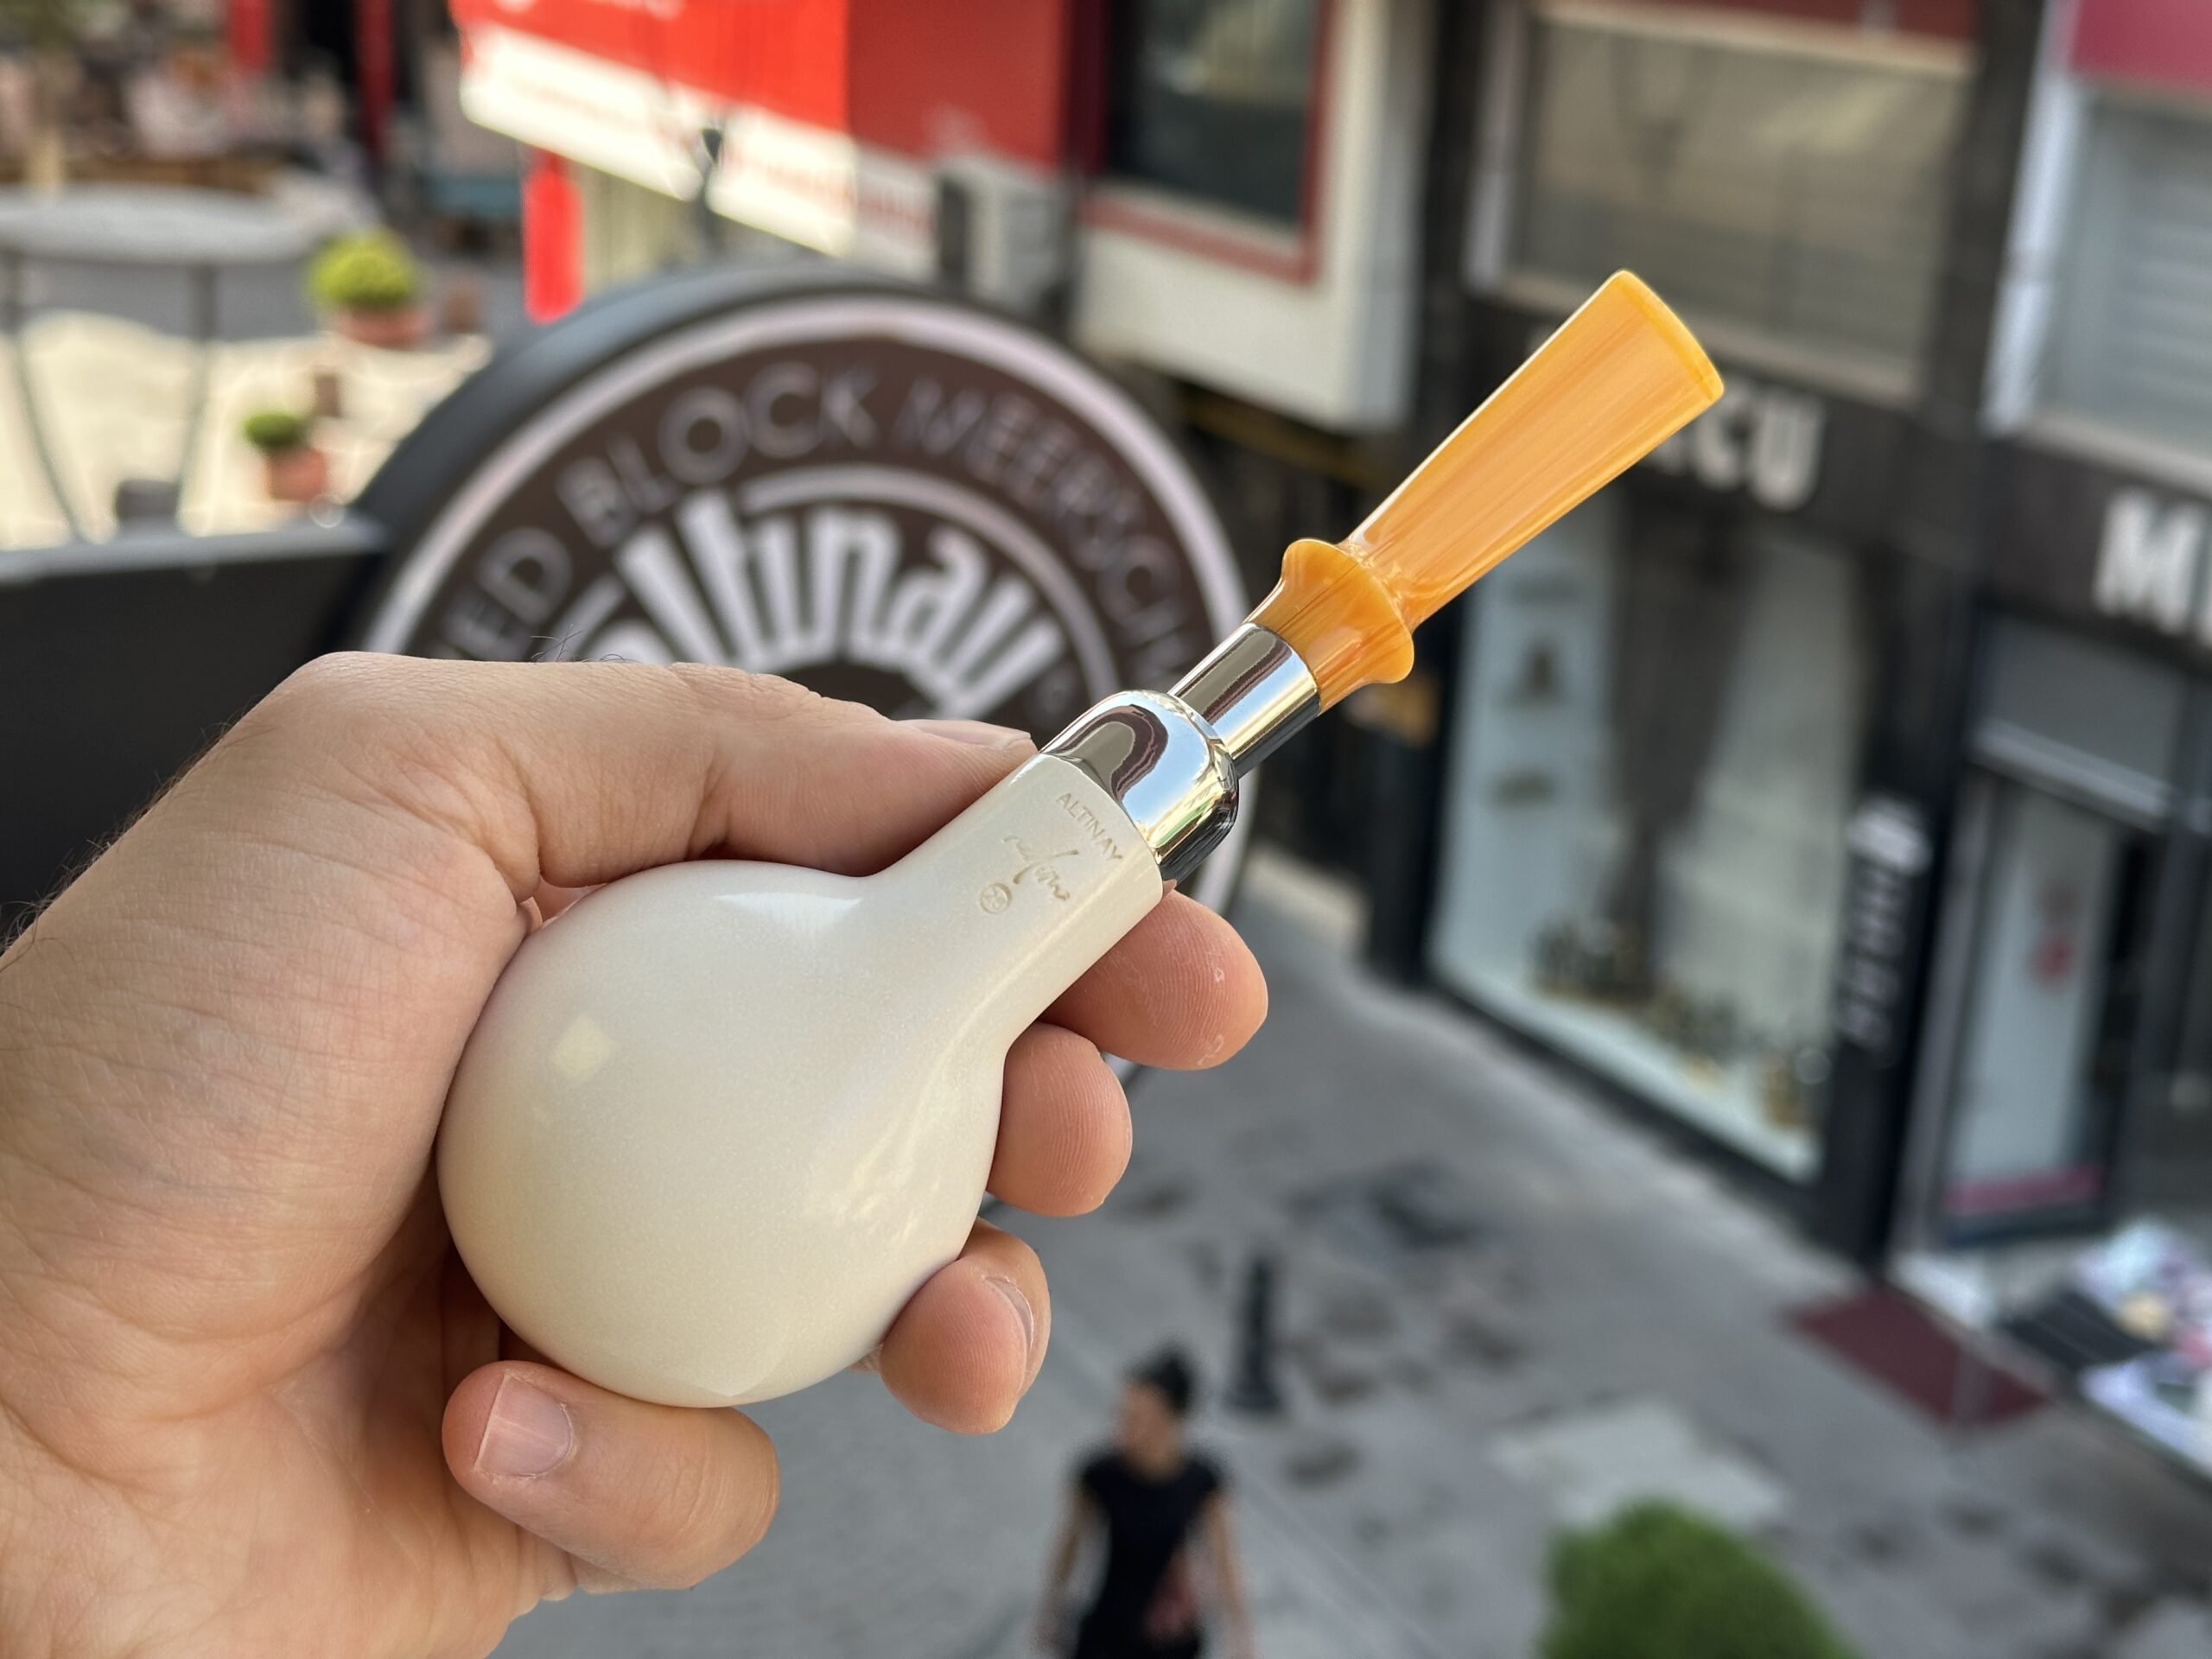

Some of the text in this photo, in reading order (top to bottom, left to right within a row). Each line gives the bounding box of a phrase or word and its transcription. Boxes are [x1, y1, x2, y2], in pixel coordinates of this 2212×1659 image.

[430, 358, 1199, 696] ED BLOCK MEERSCH
[1056, 792, 1123, 861] ALTINAY
